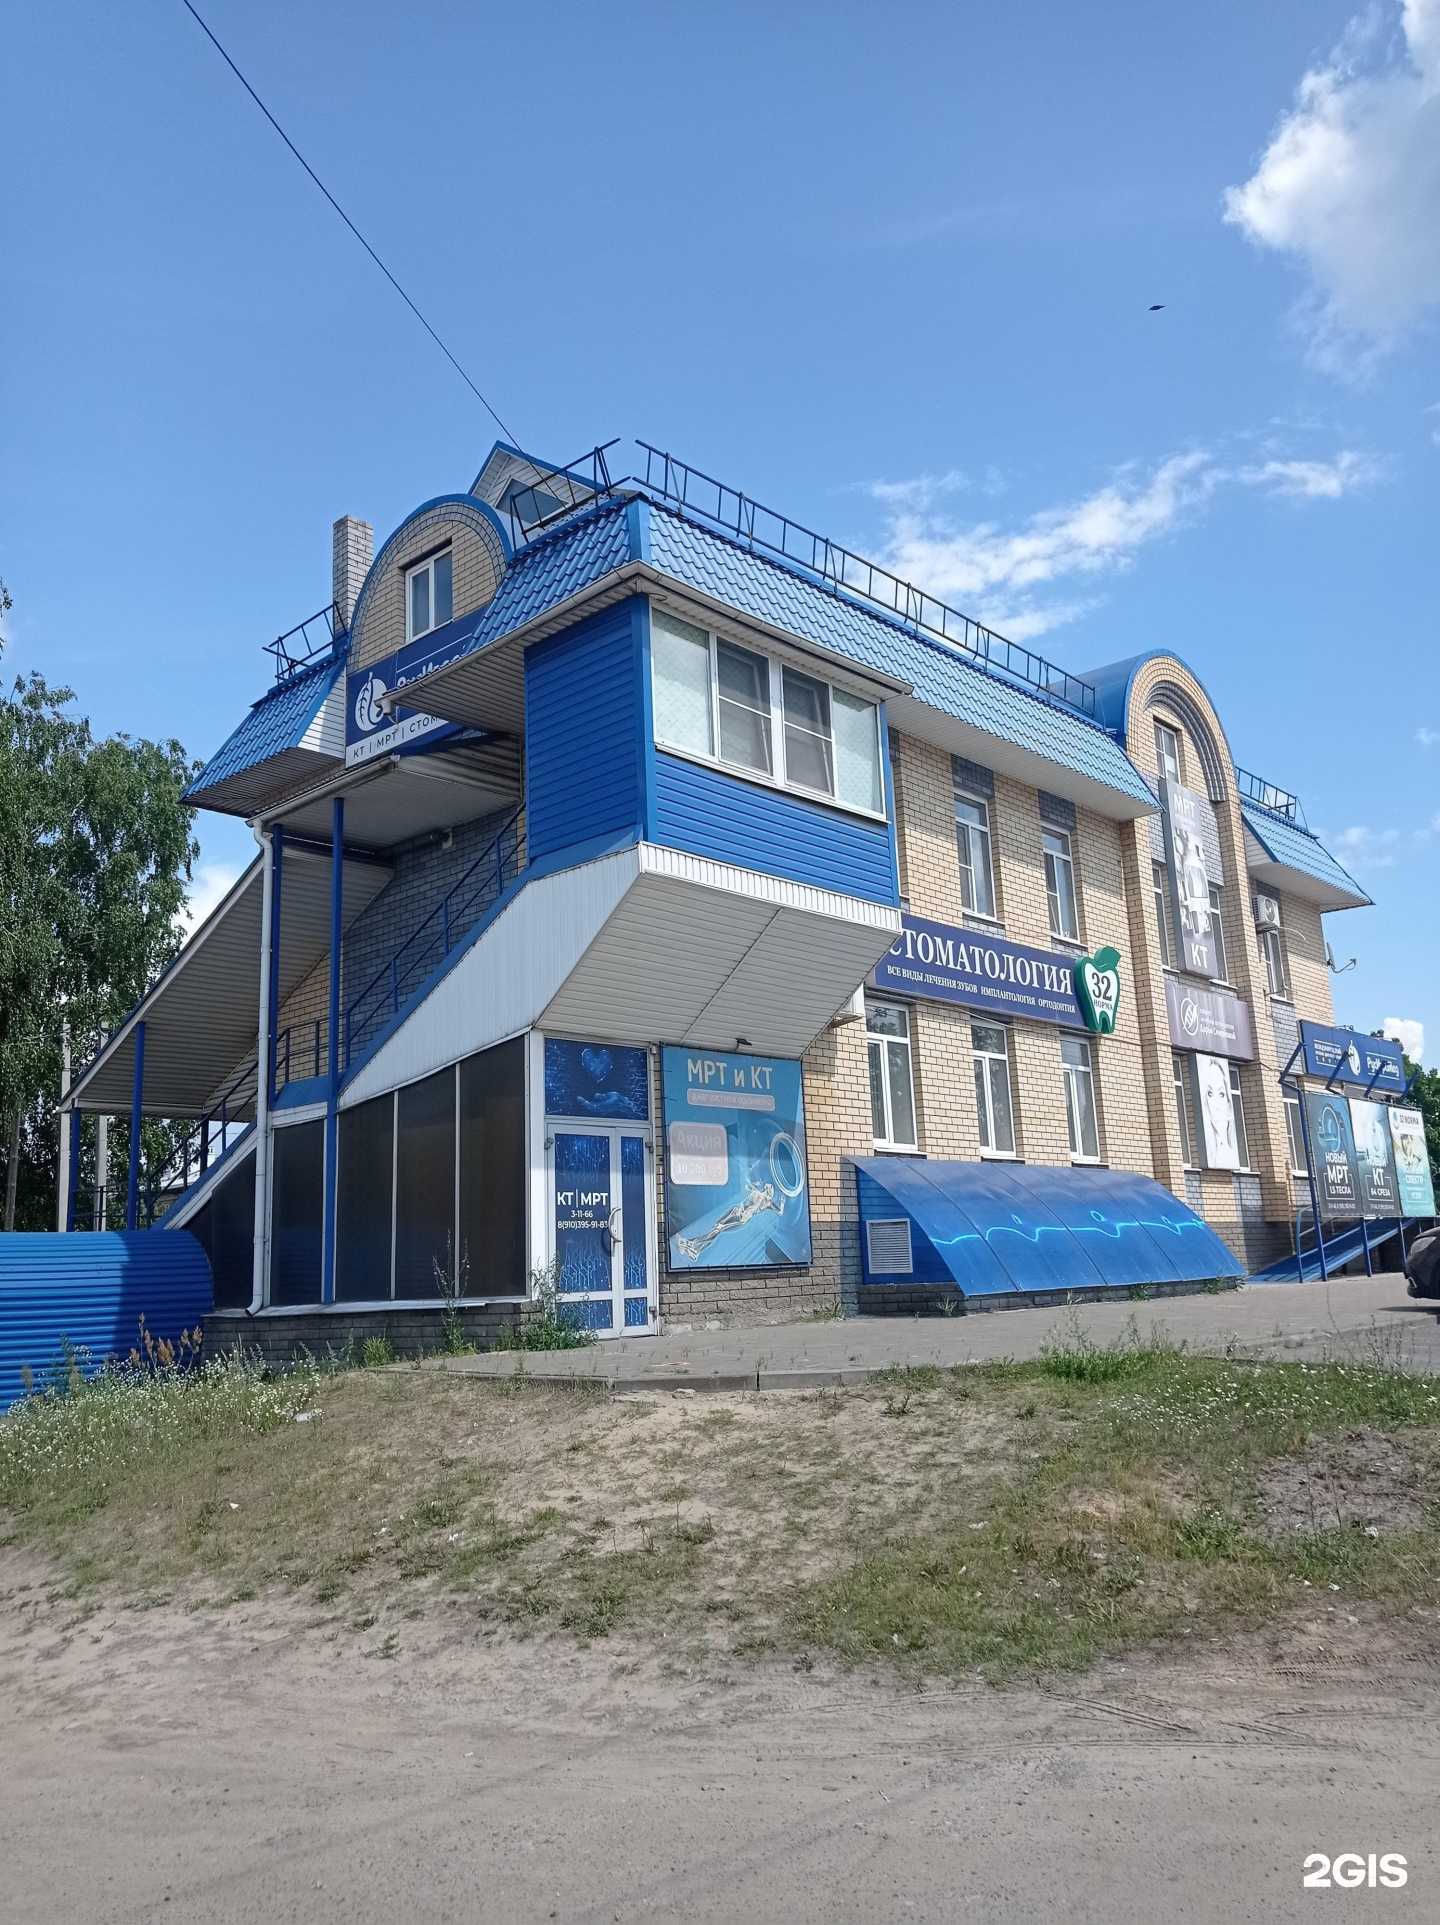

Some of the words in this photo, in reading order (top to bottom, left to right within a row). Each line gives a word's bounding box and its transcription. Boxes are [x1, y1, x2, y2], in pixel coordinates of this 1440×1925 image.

[353, 745, 366, 759] КТ
[376, 731, 398, 747] МРТ
[1173, 793, 1195, 817] МРТ
[1190, 942, 1208, 969] КТ
[887, 965, 901, 976] ВСЕ
[902, 967, 923, 981] ВИДЫ
[924, 974, 956, 989] ЛЕЧЕНИЯ
[957, 981, 978, 994] ЗУБОВ
[981, 986, 1036, 1006] ИМПЛАНТОЛОГИЯ
[1038, 998, 1076, 1014] ОРТОДОНТИЯ
[1091, 972, 1112, 1002] 32
[687, 1058, 727, 1086] МРТ
[751, 1066, 773, 1089] КТ
[1325, 1151, 1348, 1164] НОВЫЙ
[1327, 1165, 1349, 1184] МРТ
[1372, 1168, 1384, 1186] КТ
[557, 1191, 574, 1206] КТ
[580, 1192, 609, 1206] МРТ
[570, 1209, 594, 1218] 3-11-66
